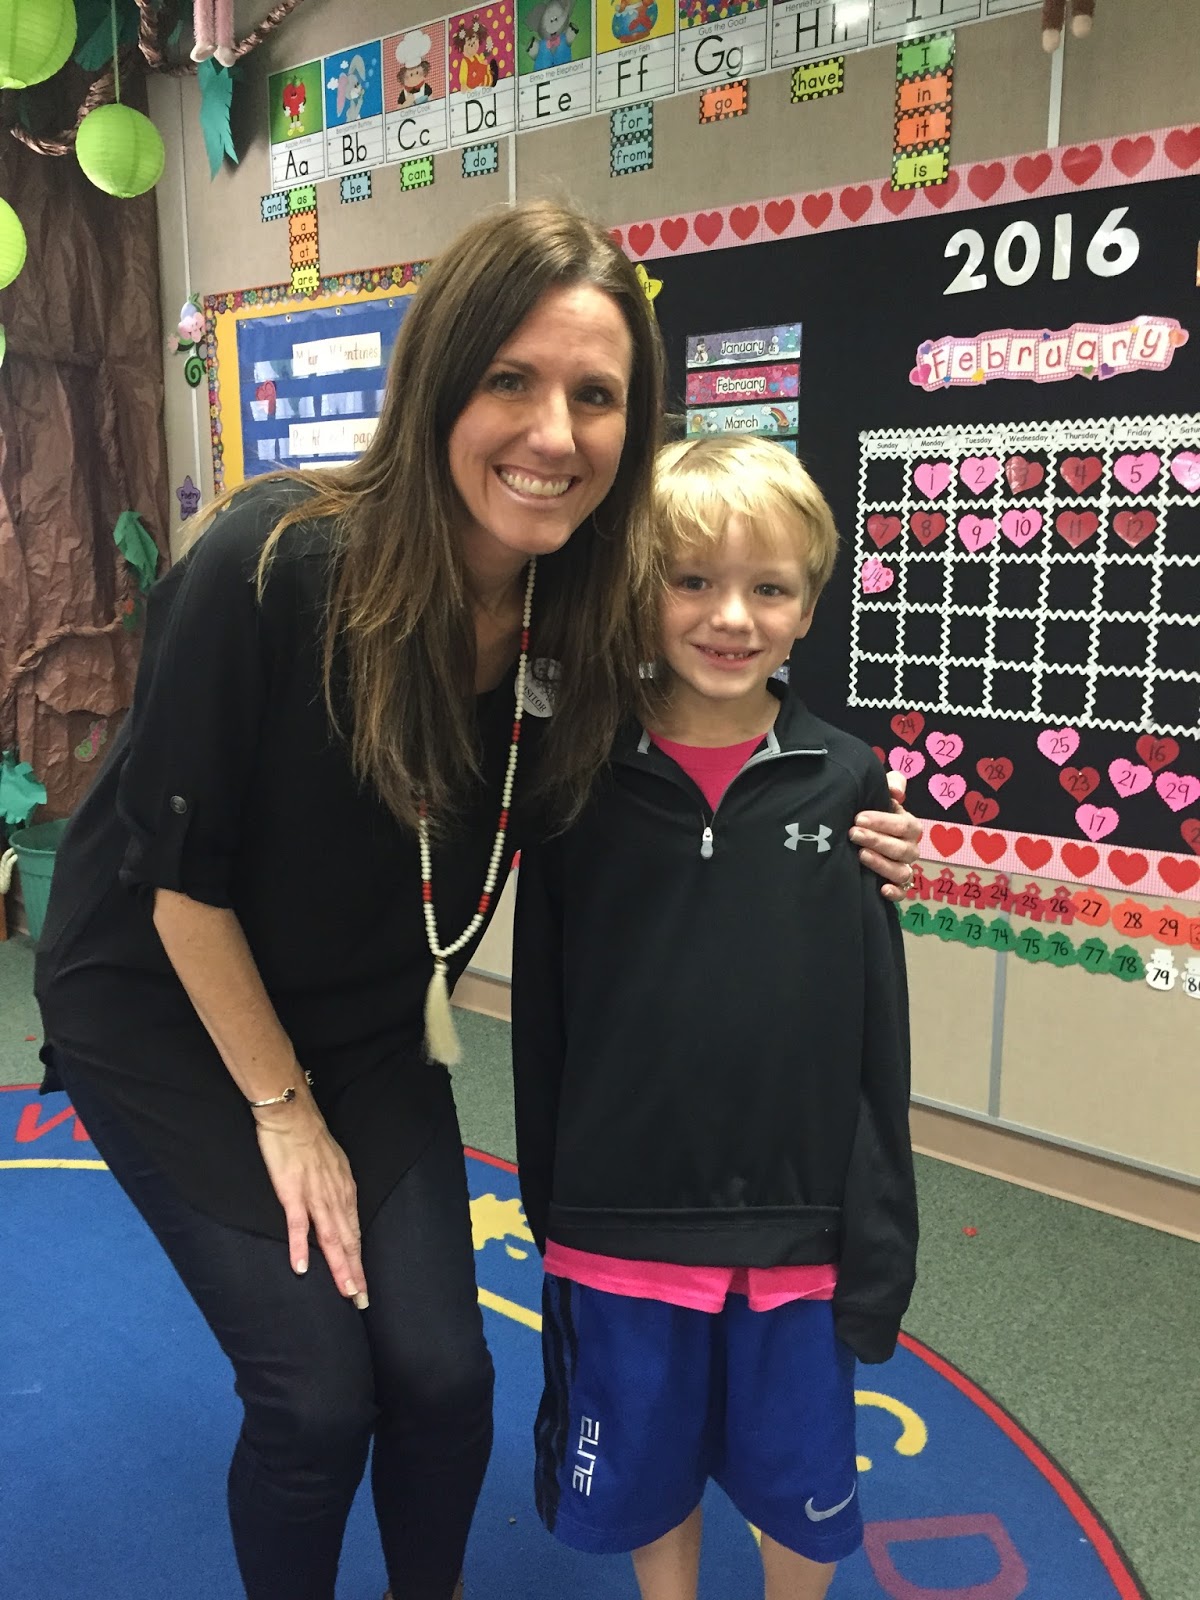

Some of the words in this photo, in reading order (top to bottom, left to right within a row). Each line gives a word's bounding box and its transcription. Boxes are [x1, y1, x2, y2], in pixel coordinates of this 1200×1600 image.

[698, 26, 713, 36] Gus
[714, 22, 726, 31] the
[727, 16, 747, 28] Goat
[694, 35, 743, 77] Gg
[921, 47, 930, 67] I
[618, 54, 648, 97] Ff
[797, 72, 837, 91] have
[536, 80, 572, 118] Ee
[917, 87, 931, 103] in
[465, 93, 497, 134] Dd
[715, 97, 732, 113] go
[620, 114, 643, 131] for
[916, 119, 930, 138] it
[398, 118, 430, 150] Cc
[342, 131, 367, 165] Bb
[285, 149, 308, 180] Aa
[473, 152, 487, 168] do
[616, 149, 648, 166] from
[408, 170, 427, 182] can
[913, 162, 927, 178] is
[350, 181, 361, 195] be
[267, 202, 282, 213] and
[297, 195, 307, 204] as
[301, 222, 306, 231] a
[300, 246, 309, 258] at
[942, 206, 1140, 295] 2016
[297, 276, 313, 286] are
[720, 340, 765, 355] January
[931, 328, 1160, 378] February
[717, 378, 765, 393] February
[724, 415, 758, 429] March
[921, 440, 945, 448] Monday
[965, 437, 992, 445] Tuesday
[1009, 434, 1049, 443] Wednesday
[1064, 432, 1099, 440] Thursday
[1127, 429, 1152, 437] Friday
[974, 466, 986, 484] 2
[1074, 464, 1087, 485] 4
[1130, 463, 1144, 484] 5
[880, 523, 889, 538] 7
[921, 520, 931, 538] 8
[972, 525, 982, 545] 9
[1015, 519, 1031, 537] 10
[1070, 519, 1081, 538] 11
[1126, 519, 1143, 538] 12
[866, 568, 883, 587] 14
[522, 684, 547, 711] ISITOR
[898, 719, 916, 734] 24
[935, 740, 955, 758] 22
[1050, 736, 1070, 754] 25
[1149, 743, 1166, 762] 16
[899, 755, 914, 773] 18
[985, 764, 1004, 780] 28
[1068, 775, 1090, 791] 23
[1118, 770, 1137, 789] 21
[939, 782, 956, 798] 26
[1165, 782, 1190, 803] 29
[973, 800, 988, 818] 19
[1089, 813, 1106, 832] 17
[937, 880, 955, 895] 22
[963, 882, 981, 899] 23
[990, 885, 1008, 901] 24
[1022, 895, 1039, 910] 25
[1050, 898, 1069, 914] 26
[1081, 899, 1102, 918] 27
[1123, 911, 1143, 929] 28
[1158, 917, 1179, 937] 29
[911, 912, 924, 927] 71
[938, 916, 953, 932] 72
[965, 923, 981, 940] 73
[992, 928, 1008, 945] 74
[1022, 938, 1040, 955] 75
[1051, 941, 1069, 956] 76
[1085, 946, 1104, 964] 77
[1116, 955, 1138, 973] 78
[1152, 967, 1170, 985] 79
[572, 1415, 600, 1496] ELITE
